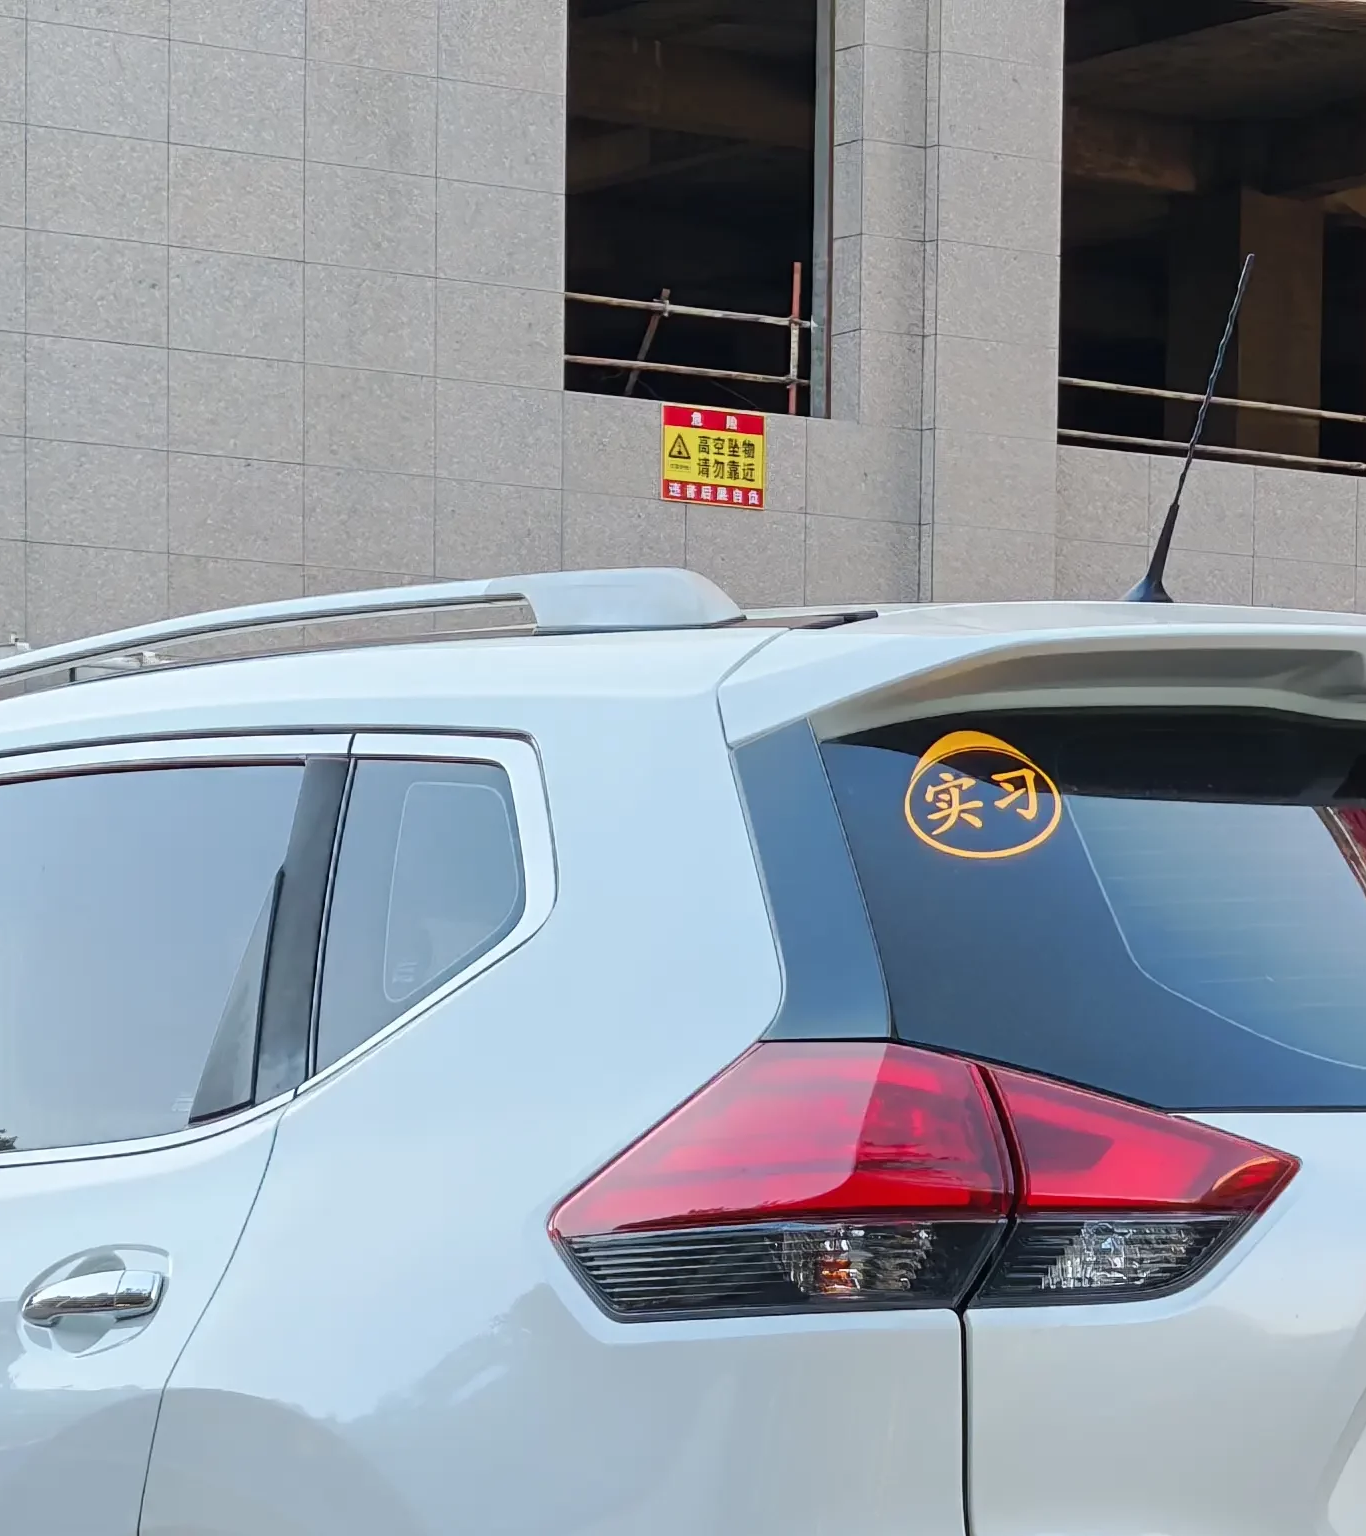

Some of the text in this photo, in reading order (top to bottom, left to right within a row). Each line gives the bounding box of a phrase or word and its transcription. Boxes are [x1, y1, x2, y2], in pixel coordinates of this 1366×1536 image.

[697, 436, 755, 459] 高空坠物
[697, 458, 756, 482] 请勿靠近
[925, 768, 1038, 835] 实习
